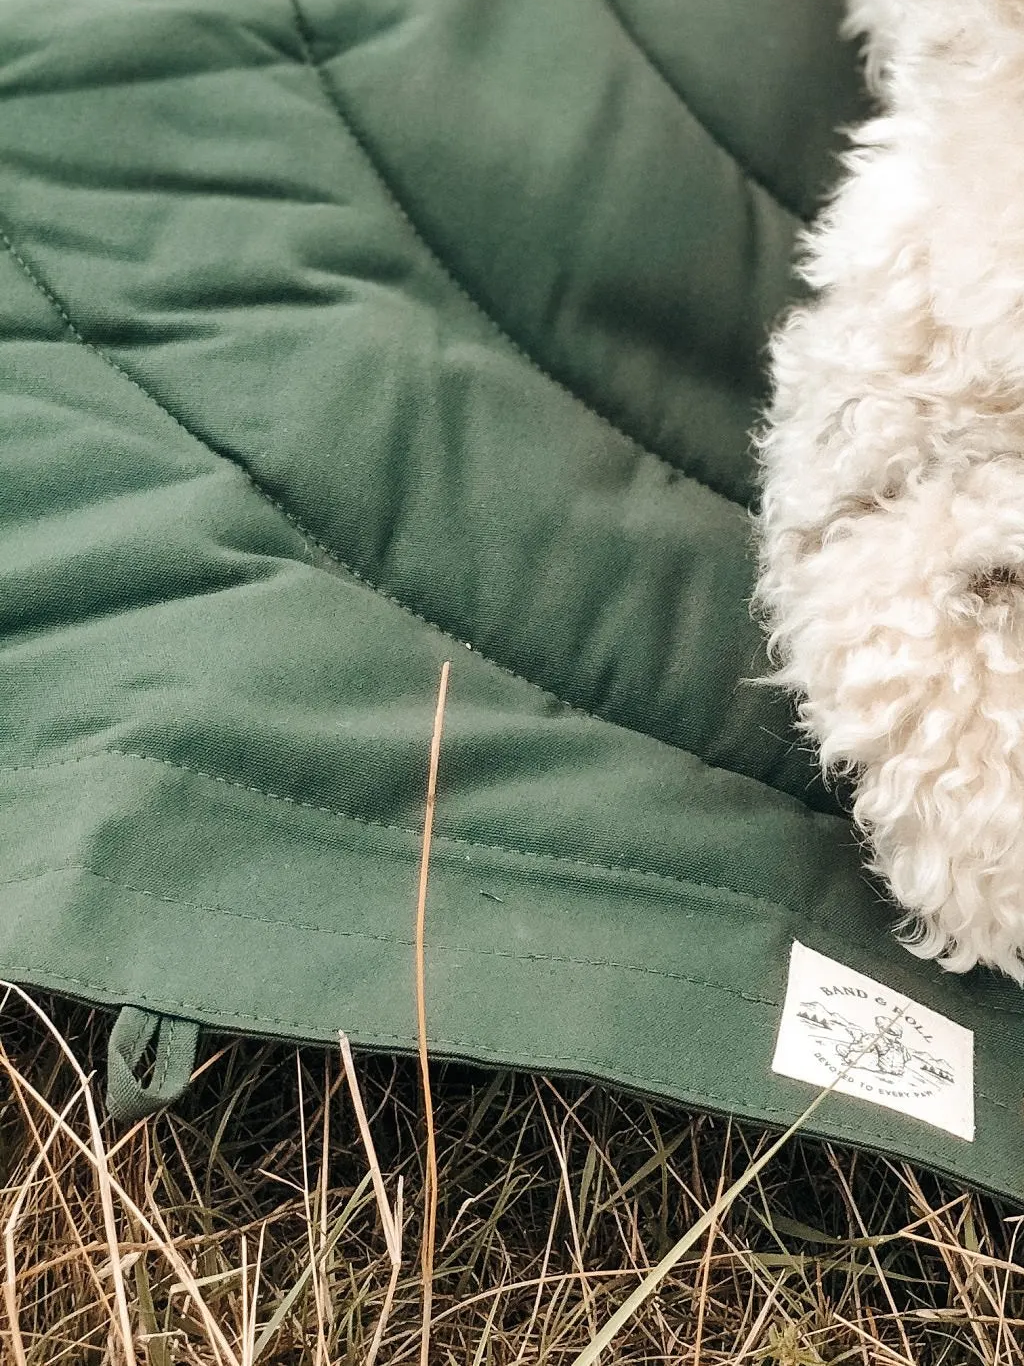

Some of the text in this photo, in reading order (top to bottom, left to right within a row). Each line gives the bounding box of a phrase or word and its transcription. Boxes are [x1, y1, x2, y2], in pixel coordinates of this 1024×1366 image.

[820, 985, 868, 999] BAND
[860, 1081, 873, 1092] TO
[878, 1088, 909, 1098] EVERY
